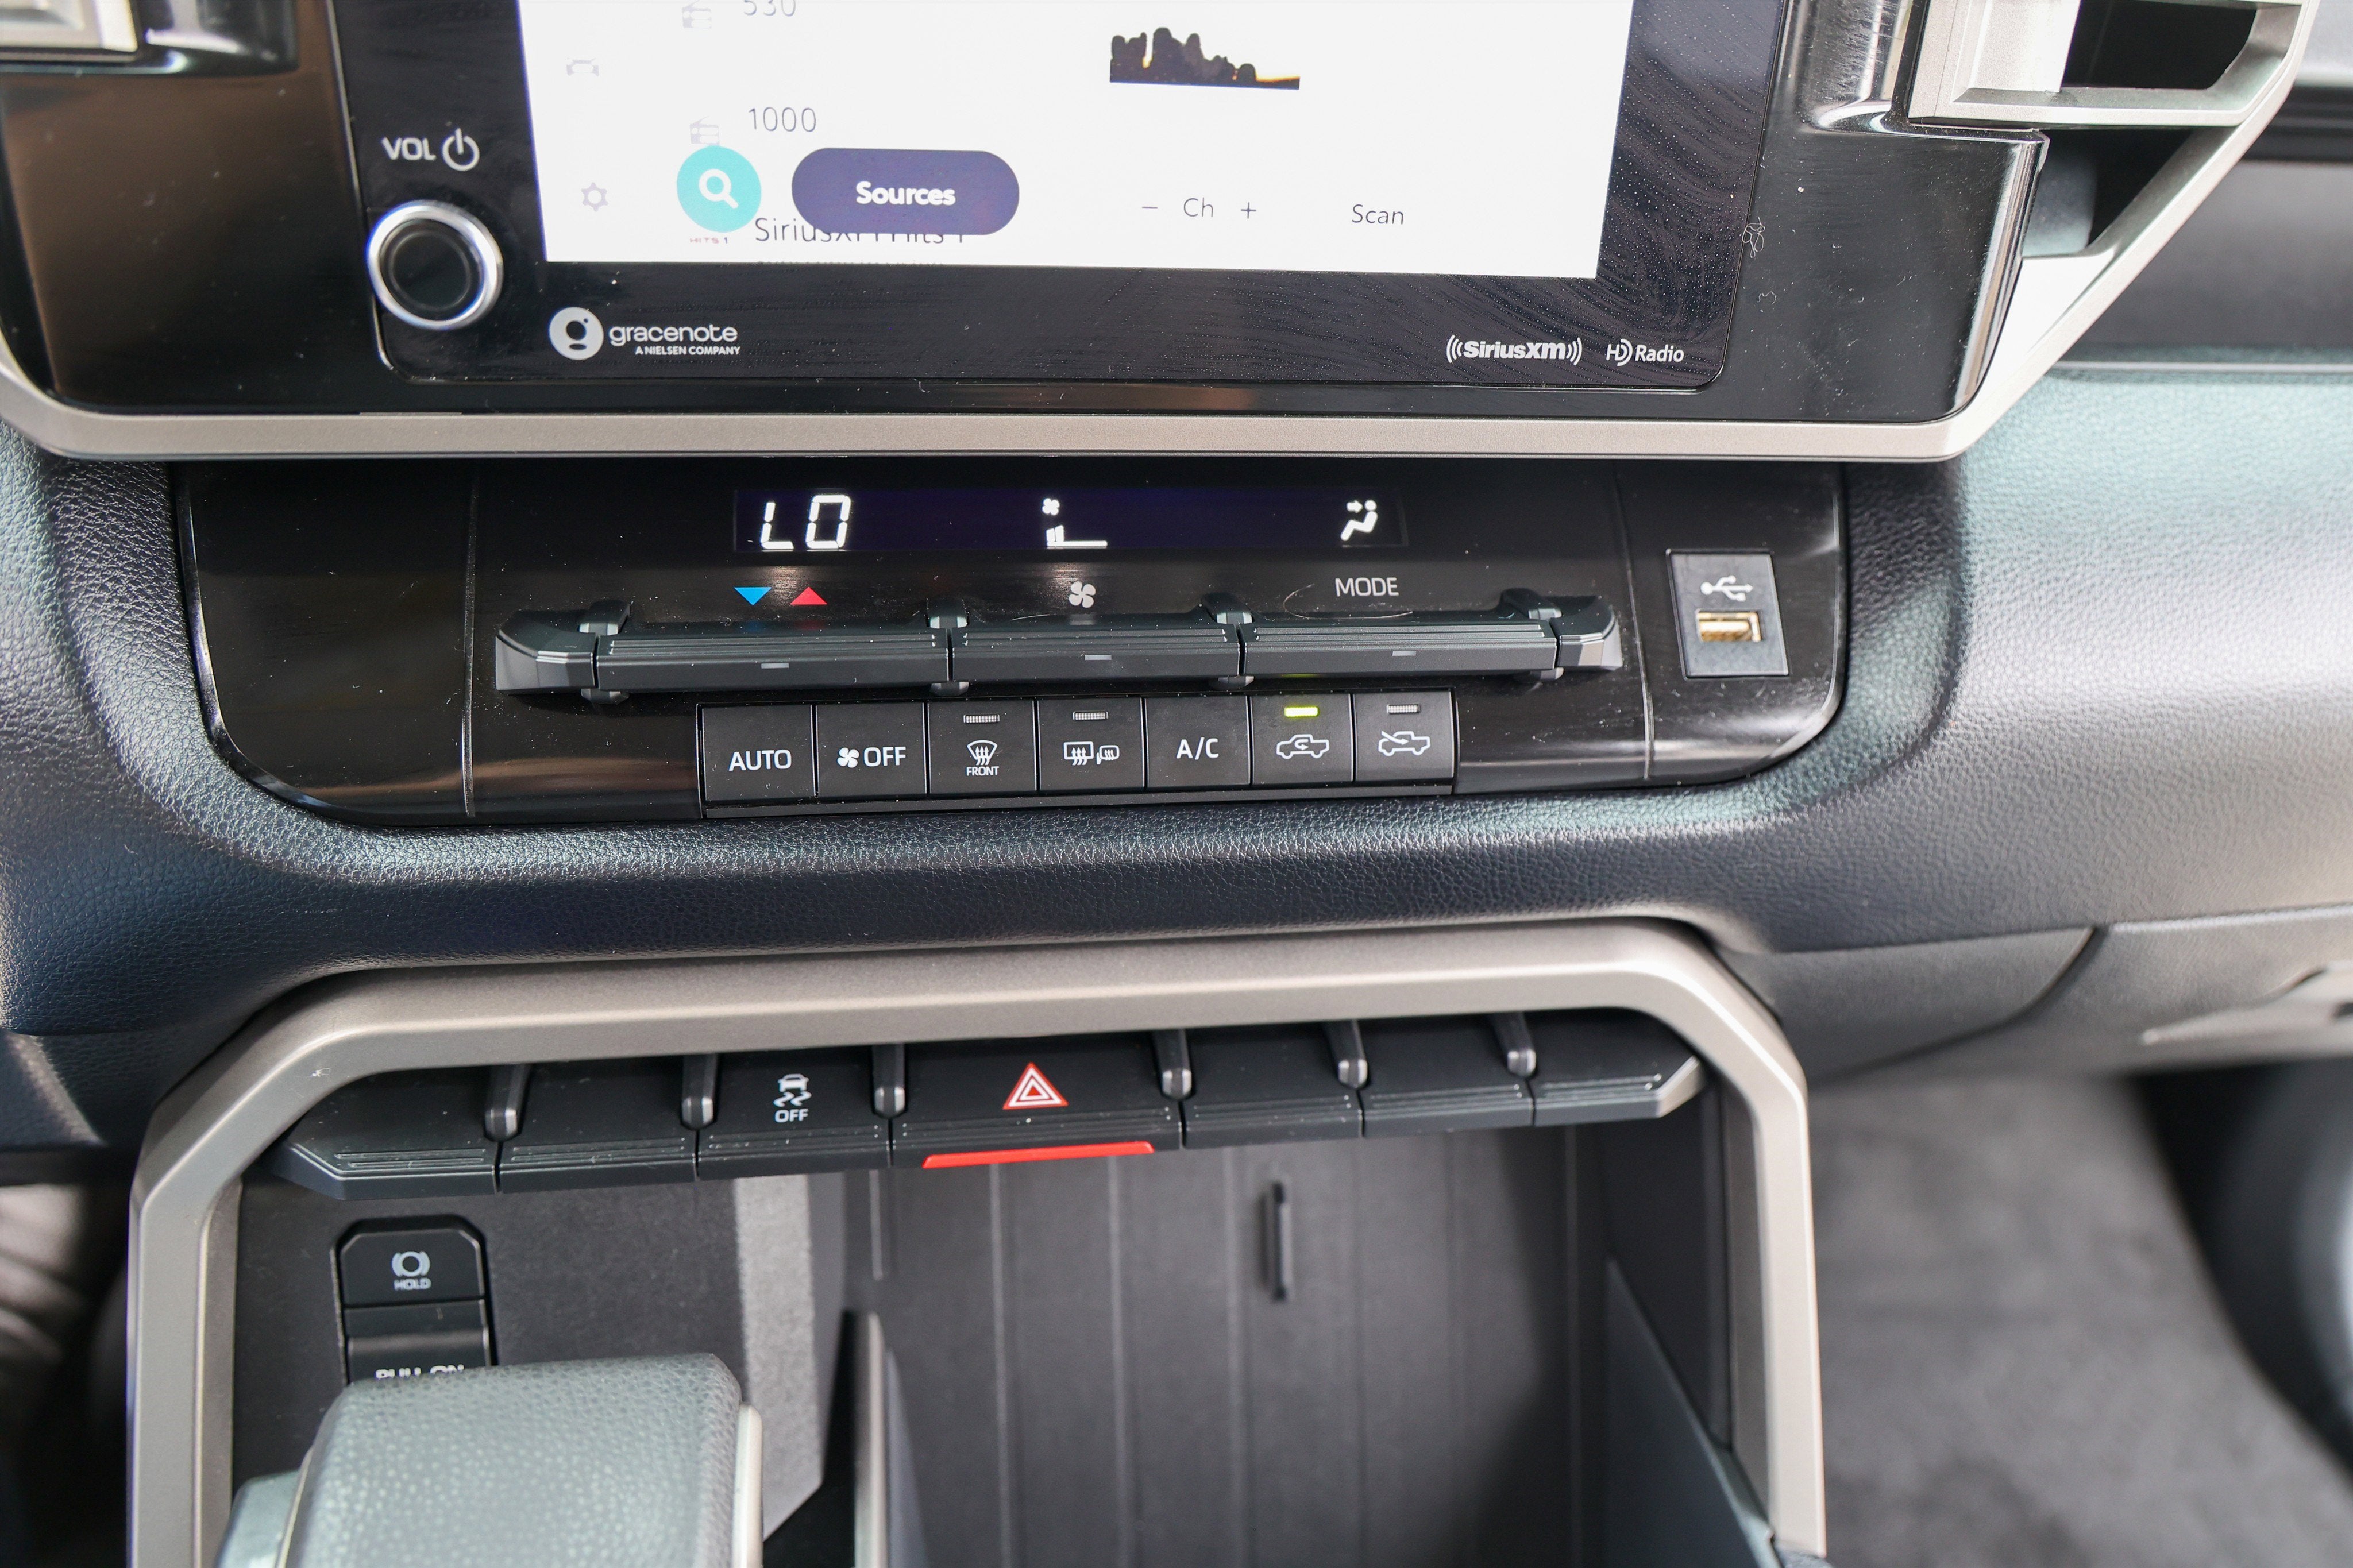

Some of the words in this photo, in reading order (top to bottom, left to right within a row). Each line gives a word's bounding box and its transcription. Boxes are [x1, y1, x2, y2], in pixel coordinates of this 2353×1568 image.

[749, 106, 816, 133] 1000
[382, 137, 436, 160] VOL
[856, 181, 956, 206] Sources
[1183, 197, 1213, 217] Ch
[1352, 204, 1404, 225] Scan
[609, 324, 738, 347] gracenote
[635, 346, 644, 356] A
[644, 346, 687, 356] NIELSEN
[688, 346, 741, 356] COMPANY
[1606, 339, 1633, 365] HD
[1635, 344, 1684, 362] Radio
[1335, 577, 1399, 597] MODE
[863, 746, 906, 767] OFF
[1176, 737, 1219, 760] A/C
[728, 749, 792, 771] AUTO
[966, 766, 1000, 776] FRONT
[775, 1109, 808, 1123] OFF
[394, 1278, 431, 1290] HOLD
